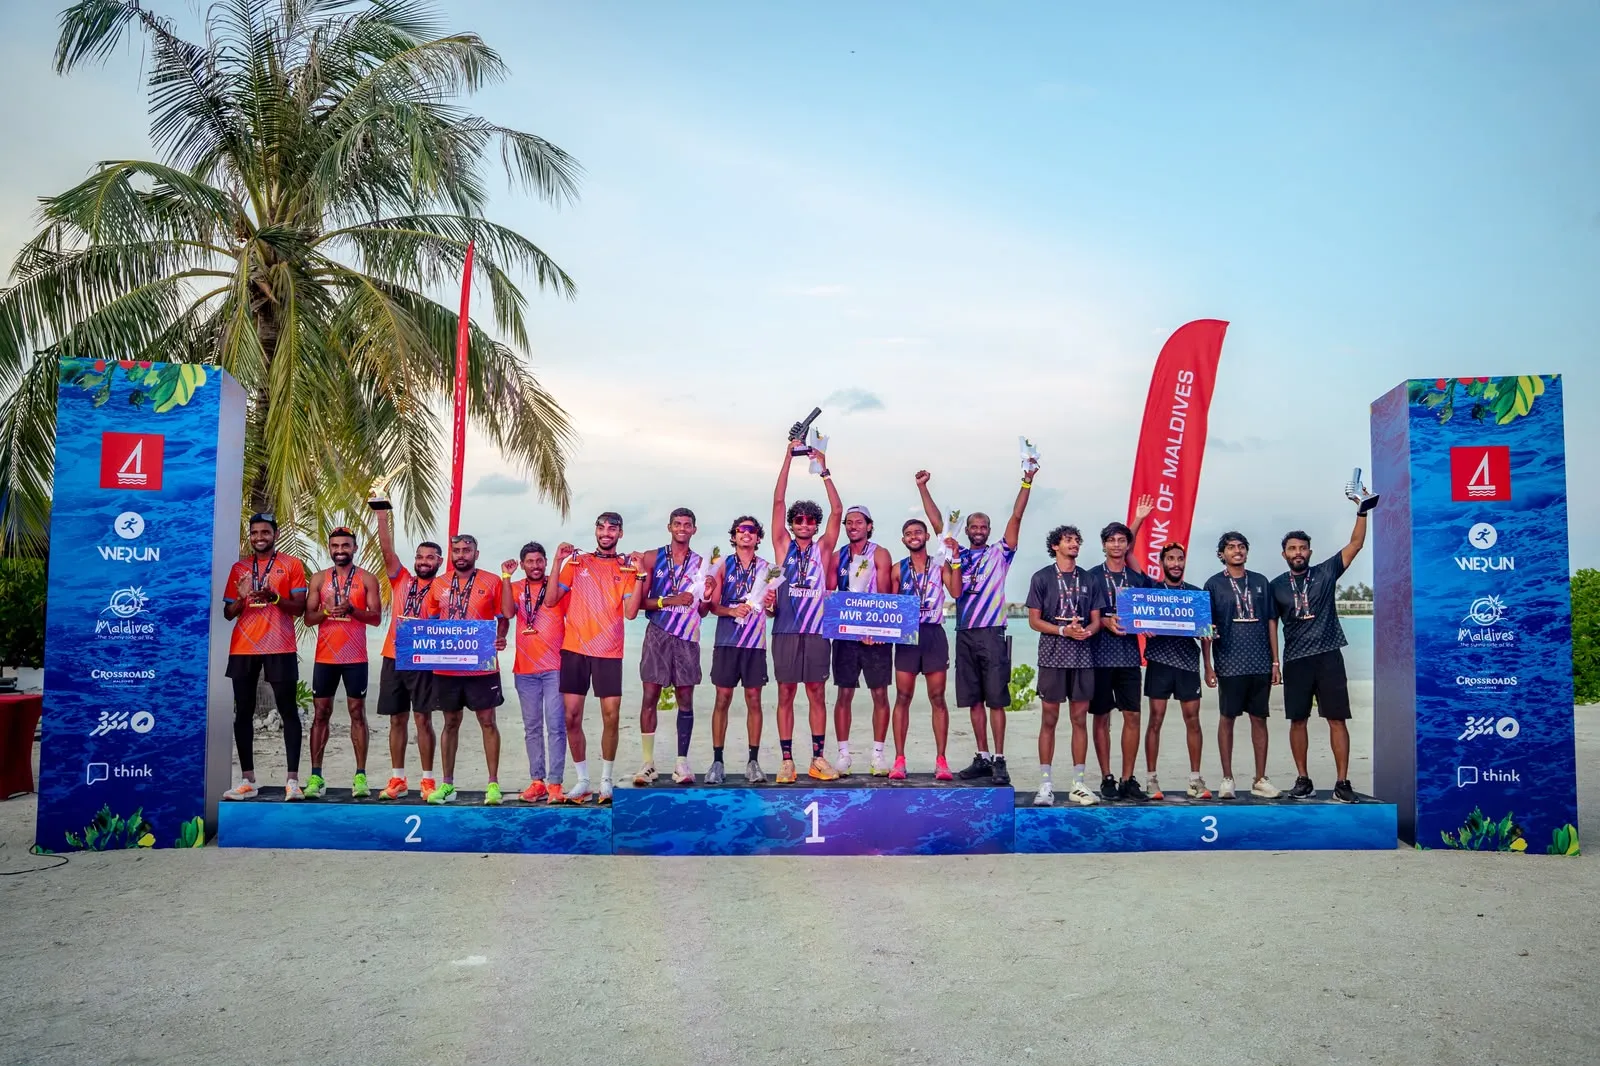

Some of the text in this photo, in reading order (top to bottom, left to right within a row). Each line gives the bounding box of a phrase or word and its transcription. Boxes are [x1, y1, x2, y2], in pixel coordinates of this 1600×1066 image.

[1147, 369, 1194, 580] BANK OF MALDIVES
[845, 598, 898, 609] CHAMPIONS
[1146, 595, 1194, 604] RUNNER-UP
[840, 611, 903, 624] MVR 20,000
[1133, 606, 1195, 618] MVR 10,000
[95, 620, 154, 635] Maldives
[426, 626, 479, 635] RUNNER-UP
[1457, 627, 1514, 642] Maldives
[412, 639, 479, 651] MVR 15,000
[91, 669, 156, 680] CROSSROADS
[1456, 675, 1518, 686] CROSSROADS
[114, 763, 153, 777] think
[1482, 768, 1521, 782] think
[404, 814, 422, 843] 2
[803, 801, 826, 844] 1
[1200, 815, 1219, 843] 3
